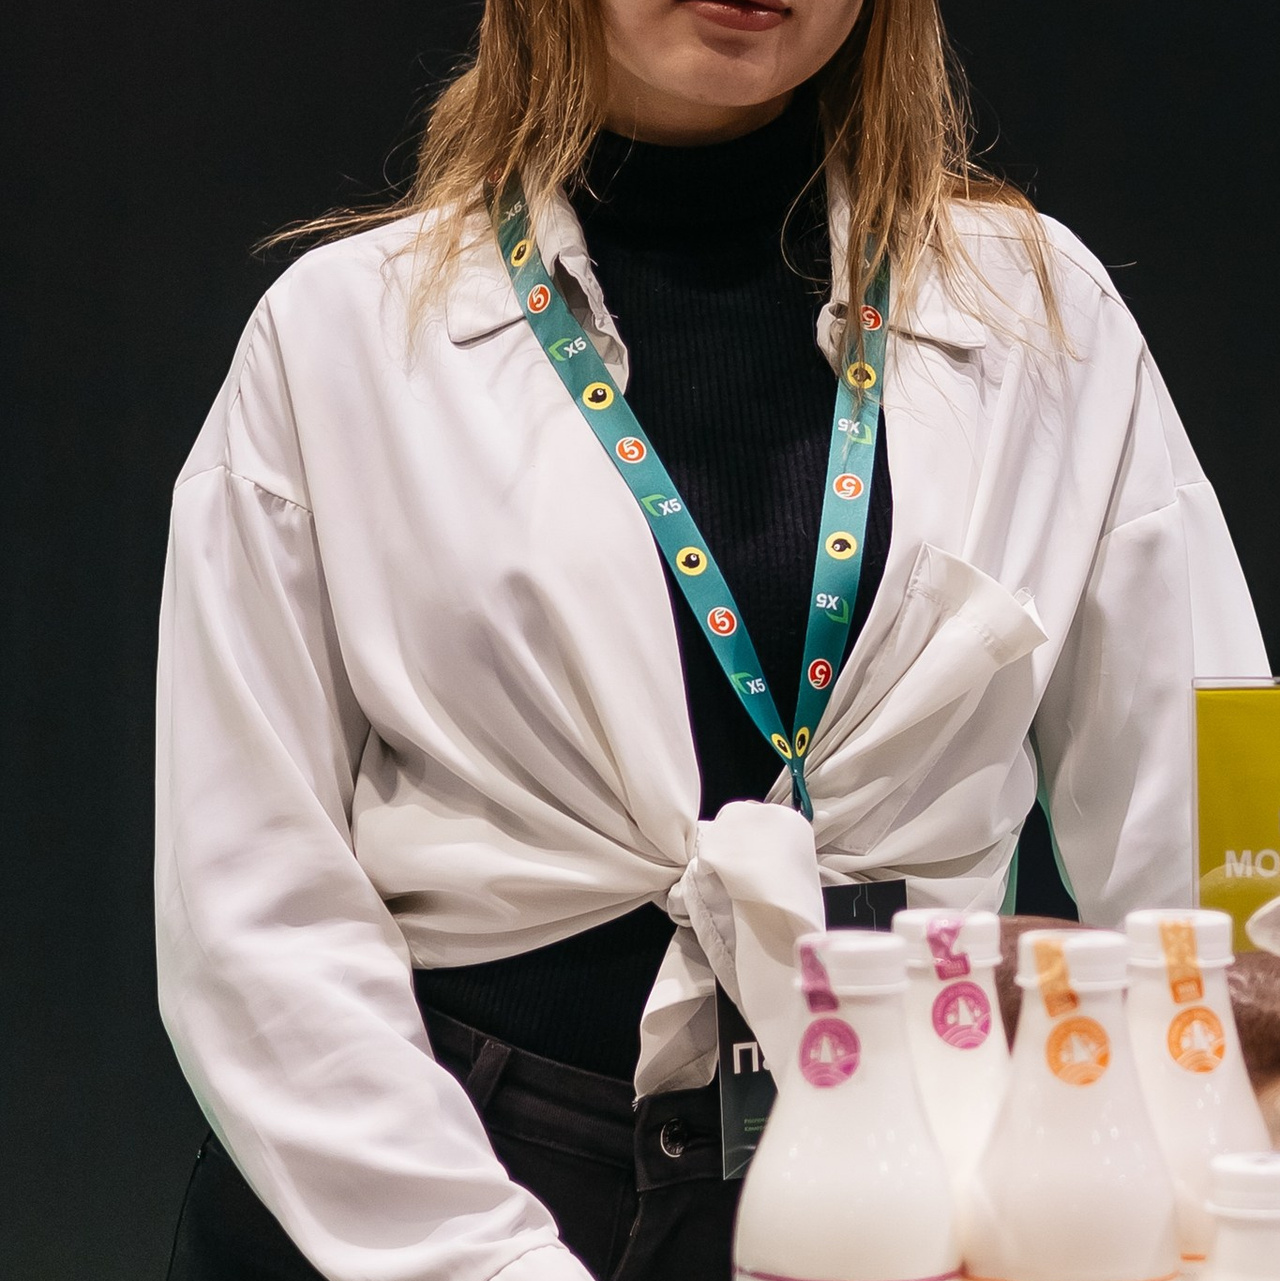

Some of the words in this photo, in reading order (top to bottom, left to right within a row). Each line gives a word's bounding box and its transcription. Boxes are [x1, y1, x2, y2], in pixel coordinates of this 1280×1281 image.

[563, 336, 588, 359] X5
[657, 498, 682, 516] X5
[815, 593, 840, 611] X5
[745, 677, 766, 695] X5
